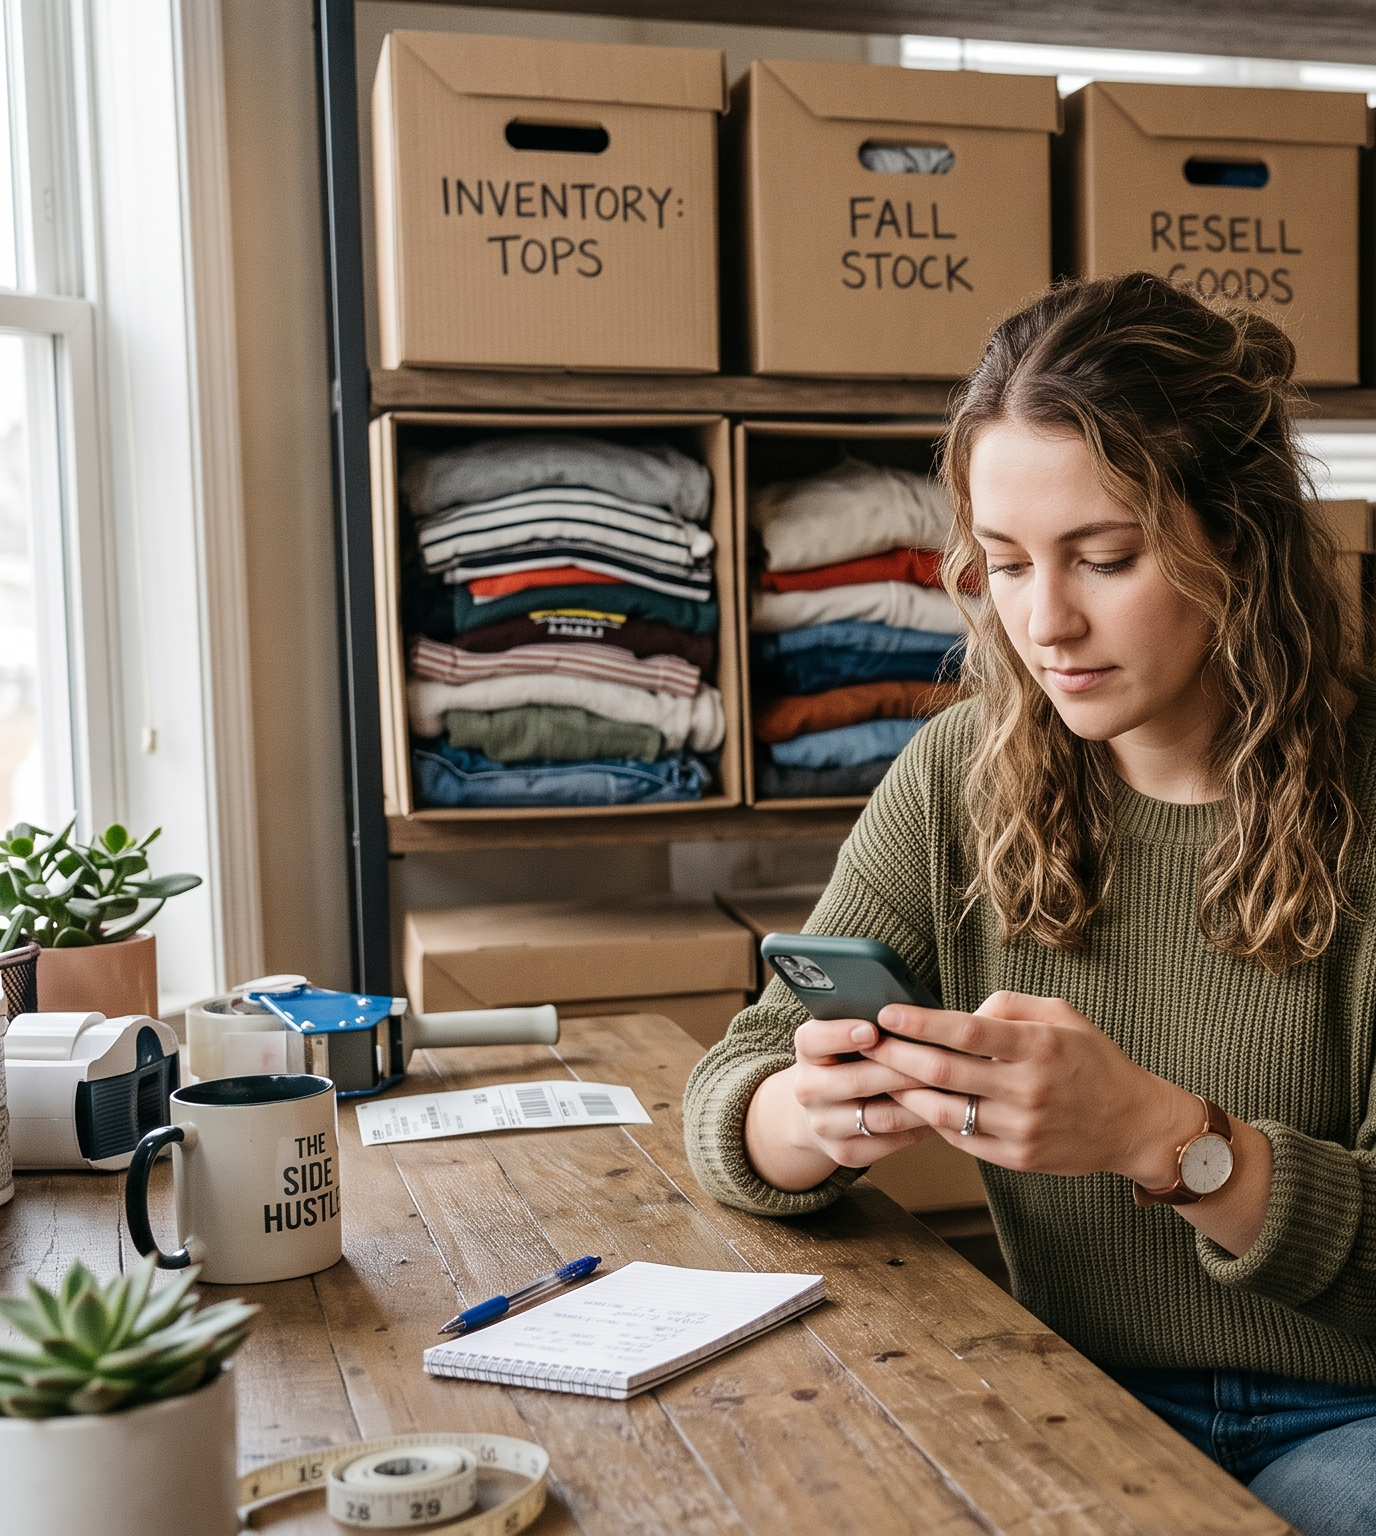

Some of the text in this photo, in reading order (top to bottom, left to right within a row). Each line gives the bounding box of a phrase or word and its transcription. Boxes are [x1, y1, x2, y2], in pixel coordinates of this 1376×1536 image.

[441, 175, 685, 229] INVENTORY:
[848, 196, 957, 239] FALL
[1151, 210, 1302, 255] RESELL
[487, 234, 603, 278] TOPS
[841, 250, 974, 293] STOCK
[294, 1132, 326, 1158] THE
[283, 1156, 333, 1196] SIDE
[410, 1497, 441, 1520] 29
